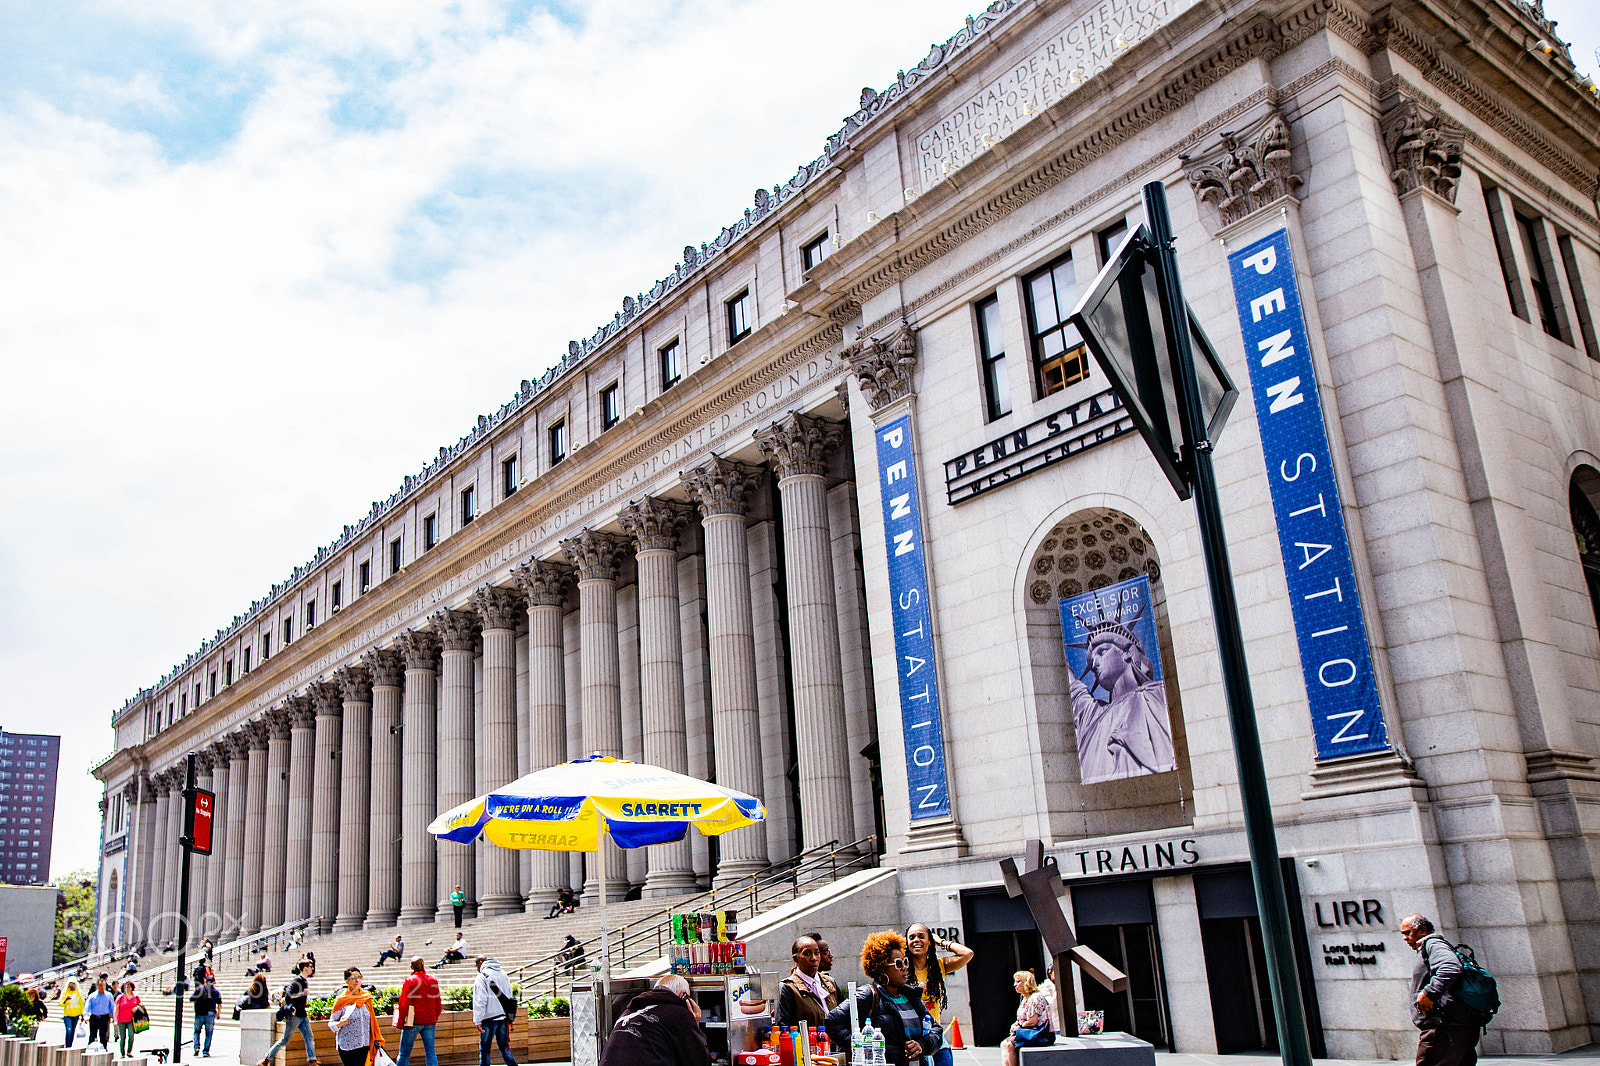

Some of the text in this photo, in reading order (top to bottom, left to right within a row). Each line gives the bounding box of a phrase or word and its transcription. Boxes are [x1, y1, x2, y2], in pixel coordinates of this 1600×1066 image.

[920, 83, 1008, 151] CARDINAL
[1016, 56, 1039, 84] DE
[1047, 0, 1129, 60] RICHEL
[923, 113, 986, 167] PUBLIC
[995, 59, 1067, 116] POSTAL
[1075, 0, 1159, 59] SERVIC
[955, 390, 1121, 476] PENN STAT
[1044, 421, 1123, 464] ENTRA
[407, 597, 425, 615] THE
[468, 524, 548, 581] COMPLETION
[554, 510, 571, 530] OF
[577, 478, 624, 516] THEIR
[631, 413, 731, 485] APPOINTED
[742, 350, 834, 419] ROUNDS
[1242, 245, 1369, 744] PENN STATION
[882, 426, 940, 809] PENN STATION
[1071, 586, 1140, 618] EXCELSIOR
[1074, 602, 1140, 630] EVER UPWARD
[495, 804, 521, 814] WE'RE
[521, 804, 533, 813] ON
[533, 804, 540, 813] A
[541, 805, 563, 814] ROLL
[621, 802, 702, 817] SABRETT
[1075, 839, 1200, 875] TRAINS
[1314, 899, 1385, 928] LIRR
[1322, 941, 1385, 956] Long Island
[1324, 954, 1377, 966] Rail Road
